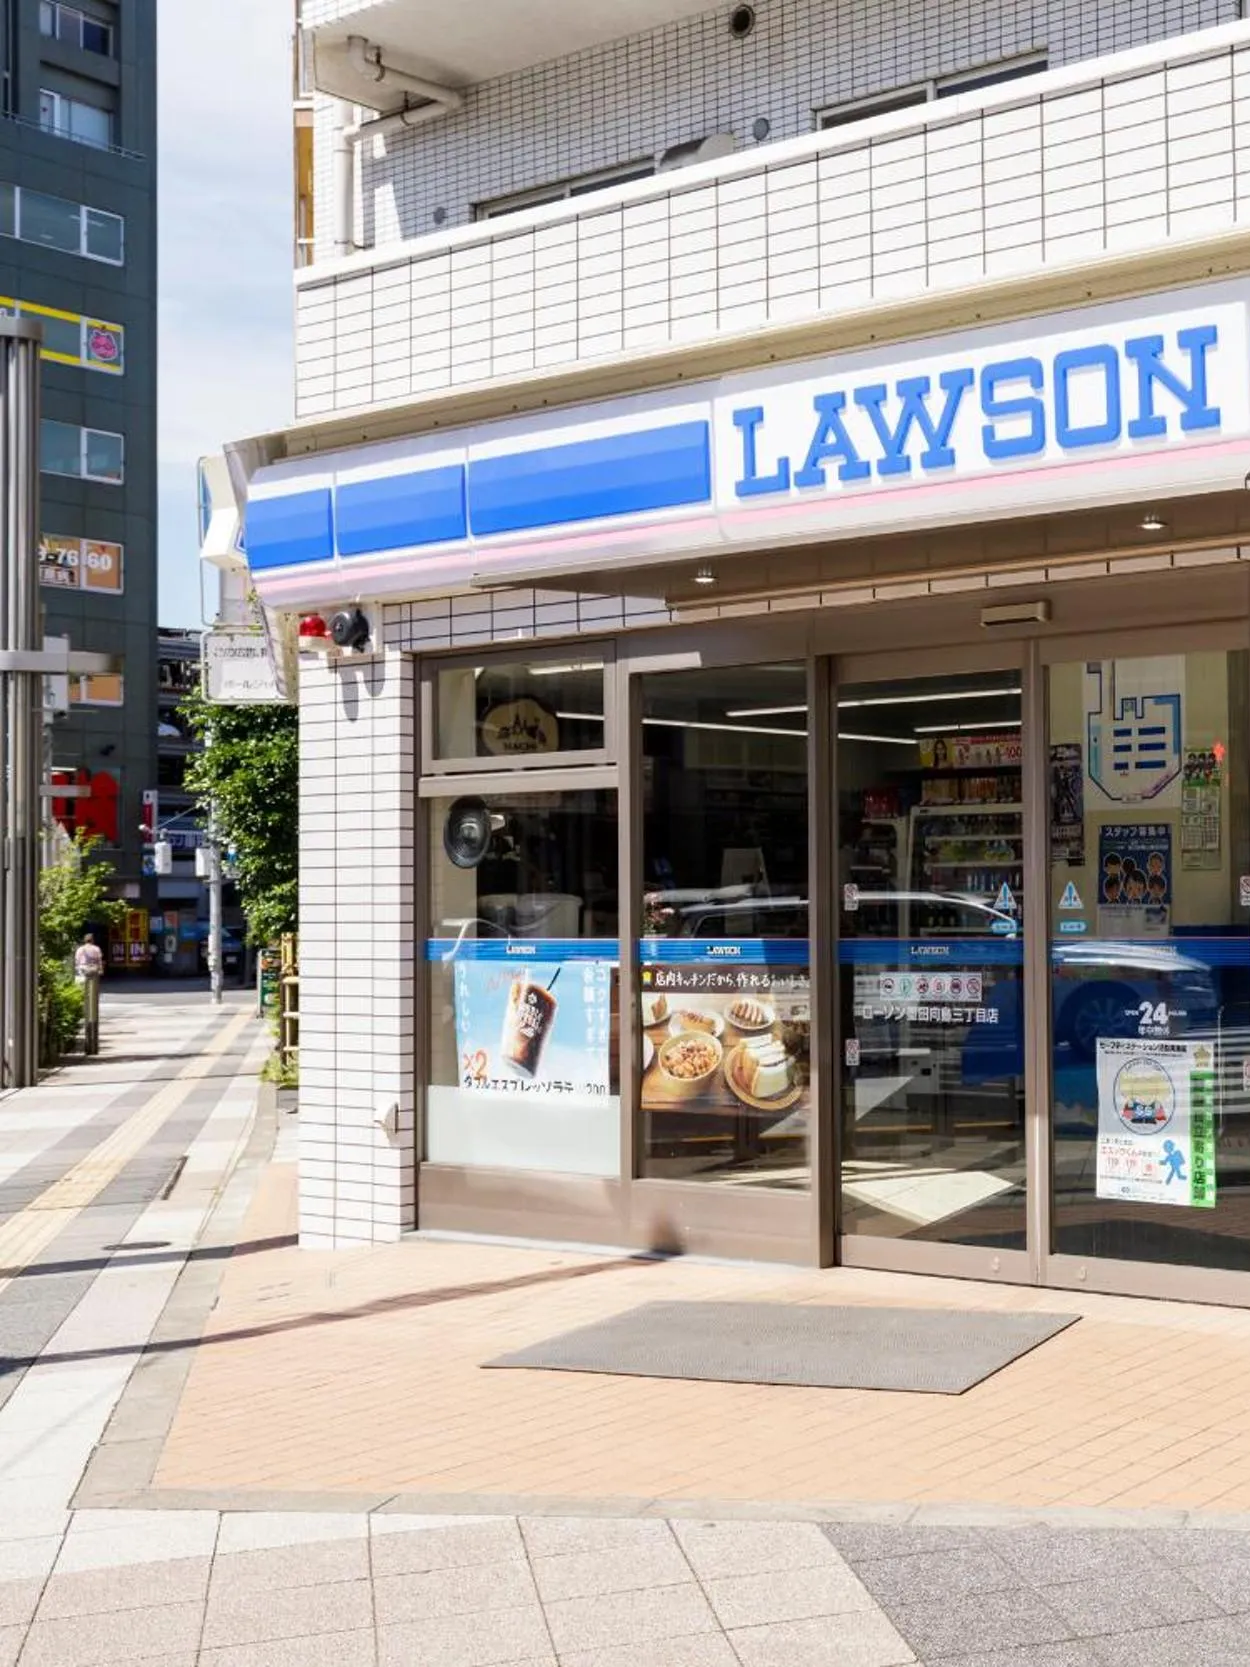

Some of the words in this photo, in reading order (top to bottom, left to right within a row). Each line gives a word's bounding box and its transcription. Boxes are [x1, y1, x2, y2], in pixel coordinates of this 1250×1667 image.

[732, 324, 1221, 497] LAWSON
[1105, 826, 1166, 837] スタッフ募集中
[1139, 1001, 1169, 1025] 24
